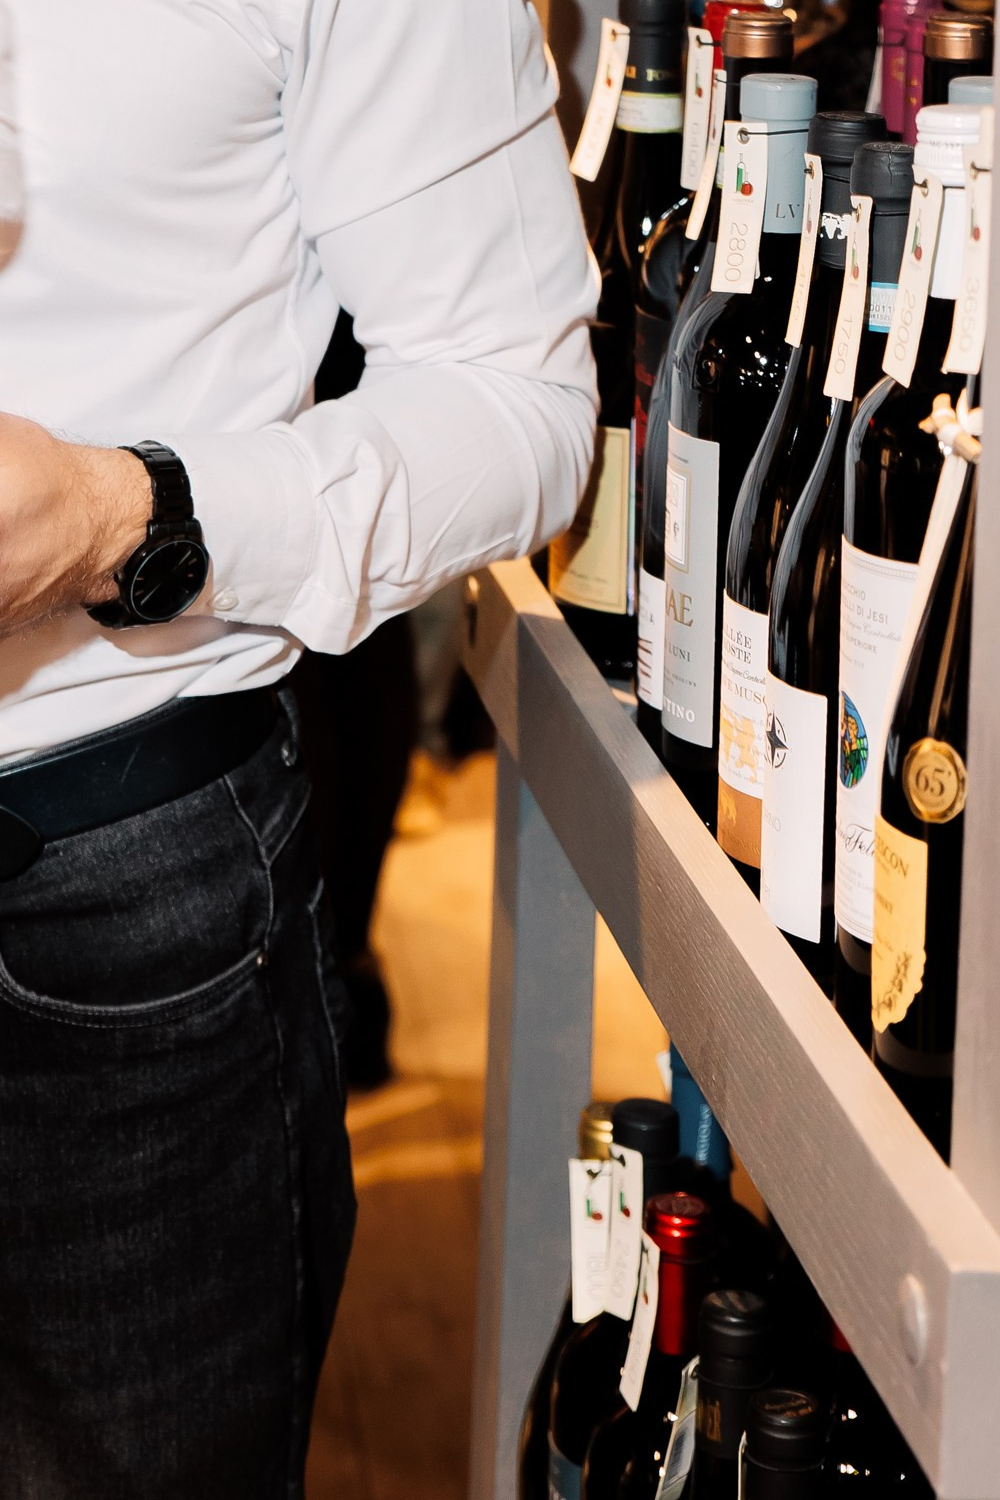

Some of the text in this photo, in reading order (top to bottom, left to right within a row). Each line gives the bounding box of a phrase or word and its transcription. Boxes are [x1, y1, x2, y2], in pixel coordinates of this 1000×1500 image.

[775, 203, 804, 219] LV
[725, 222, 749, 282] 2800
[893, 288, 917, 362] 2900
[834, 315, 853, 375] 1750
[665, 584, 694, 628] AE
[866, 608, 888, 625] JESI
[723, 624, 752, 650] LLÉE
[723, 640, 752, 665] OSTE
[664, 697, 695, 723] TINO
